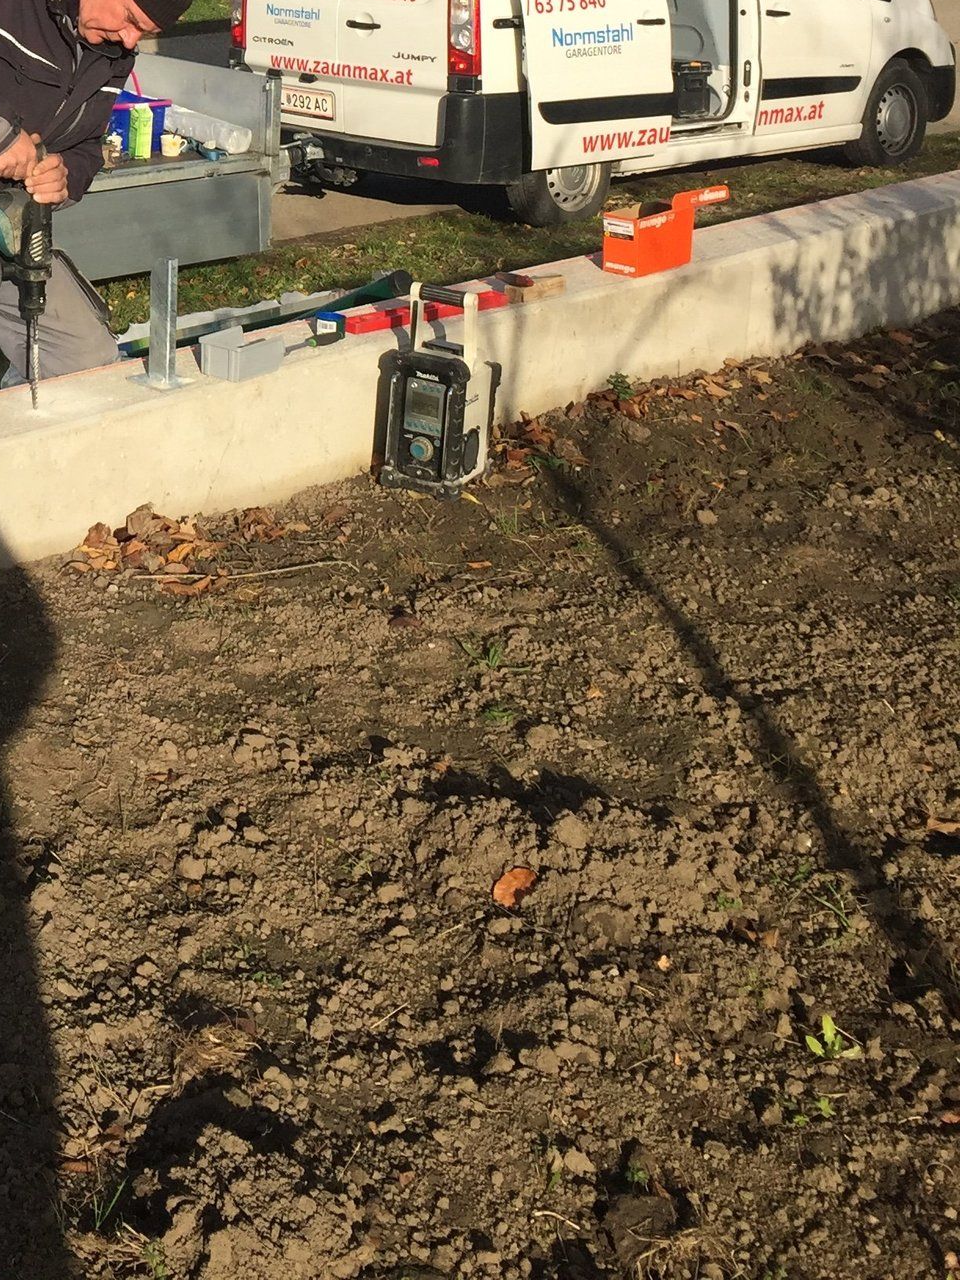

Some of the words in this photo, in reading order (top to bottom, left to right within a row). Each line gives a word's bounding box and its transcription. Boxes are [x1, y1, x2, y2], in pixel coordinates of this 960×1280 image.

[266, 3, 320, 21] Normstahl
[552, 23, 633, 48] Normstahl
[392, 51, 437, 63] JUMPY
[565, 45, 623, 59] GARAGENTORE
[270, 53, 414, 86] www.zaunmax.at
[292, 93, 311, 110] 292
[314, 97, 328, 113] AC
[582, 126, 671, 154] www.zau
